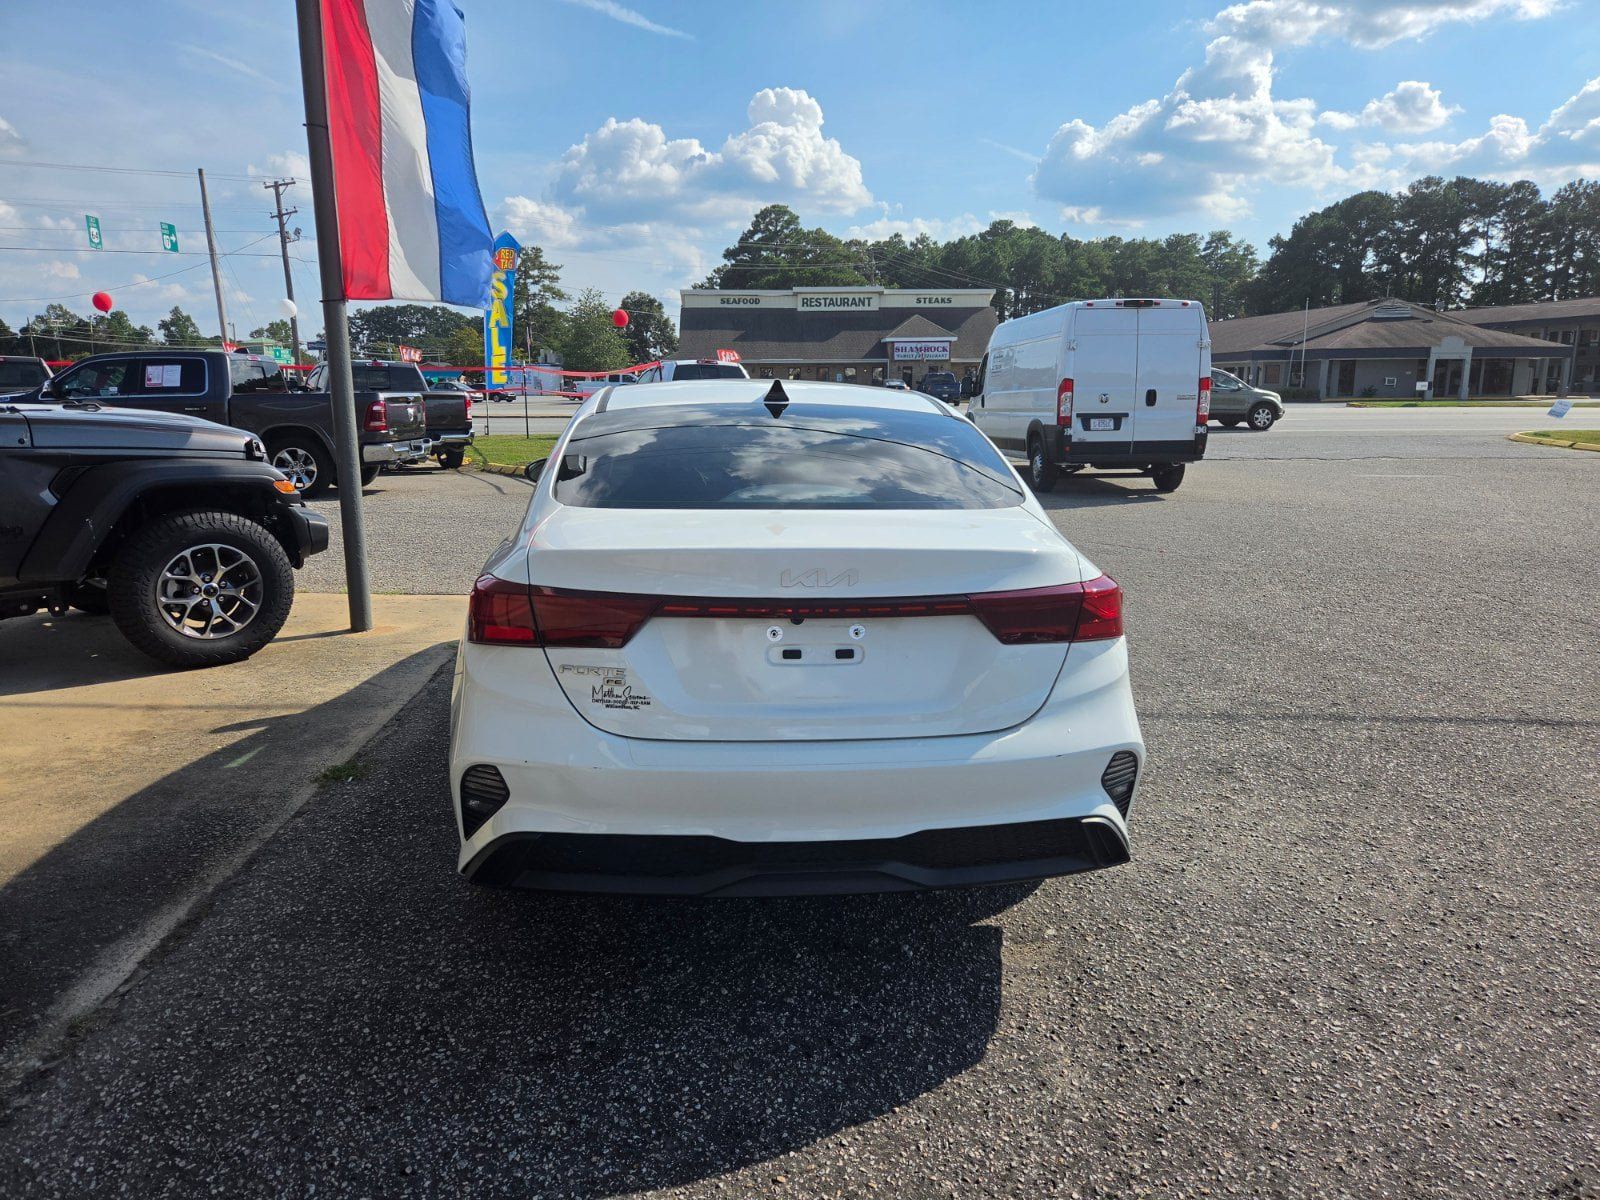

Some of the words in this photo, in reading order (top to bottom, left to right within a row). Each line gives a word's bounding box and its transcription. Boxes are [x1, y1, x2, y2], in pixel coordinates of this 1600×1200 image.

[500, 249, 514, 259] RED
[500, 259, 513, 269] TAG
[720, 297, 760, 305] SEAFOOD
[802, 297, 872, 307] RESTAURANT
[916, 296, 952, 304] STEAKS
[489, 271, 509, 384] SALE
[780, 568, 860, 587] KIA
[559, 664, 626, 677] FORTE
